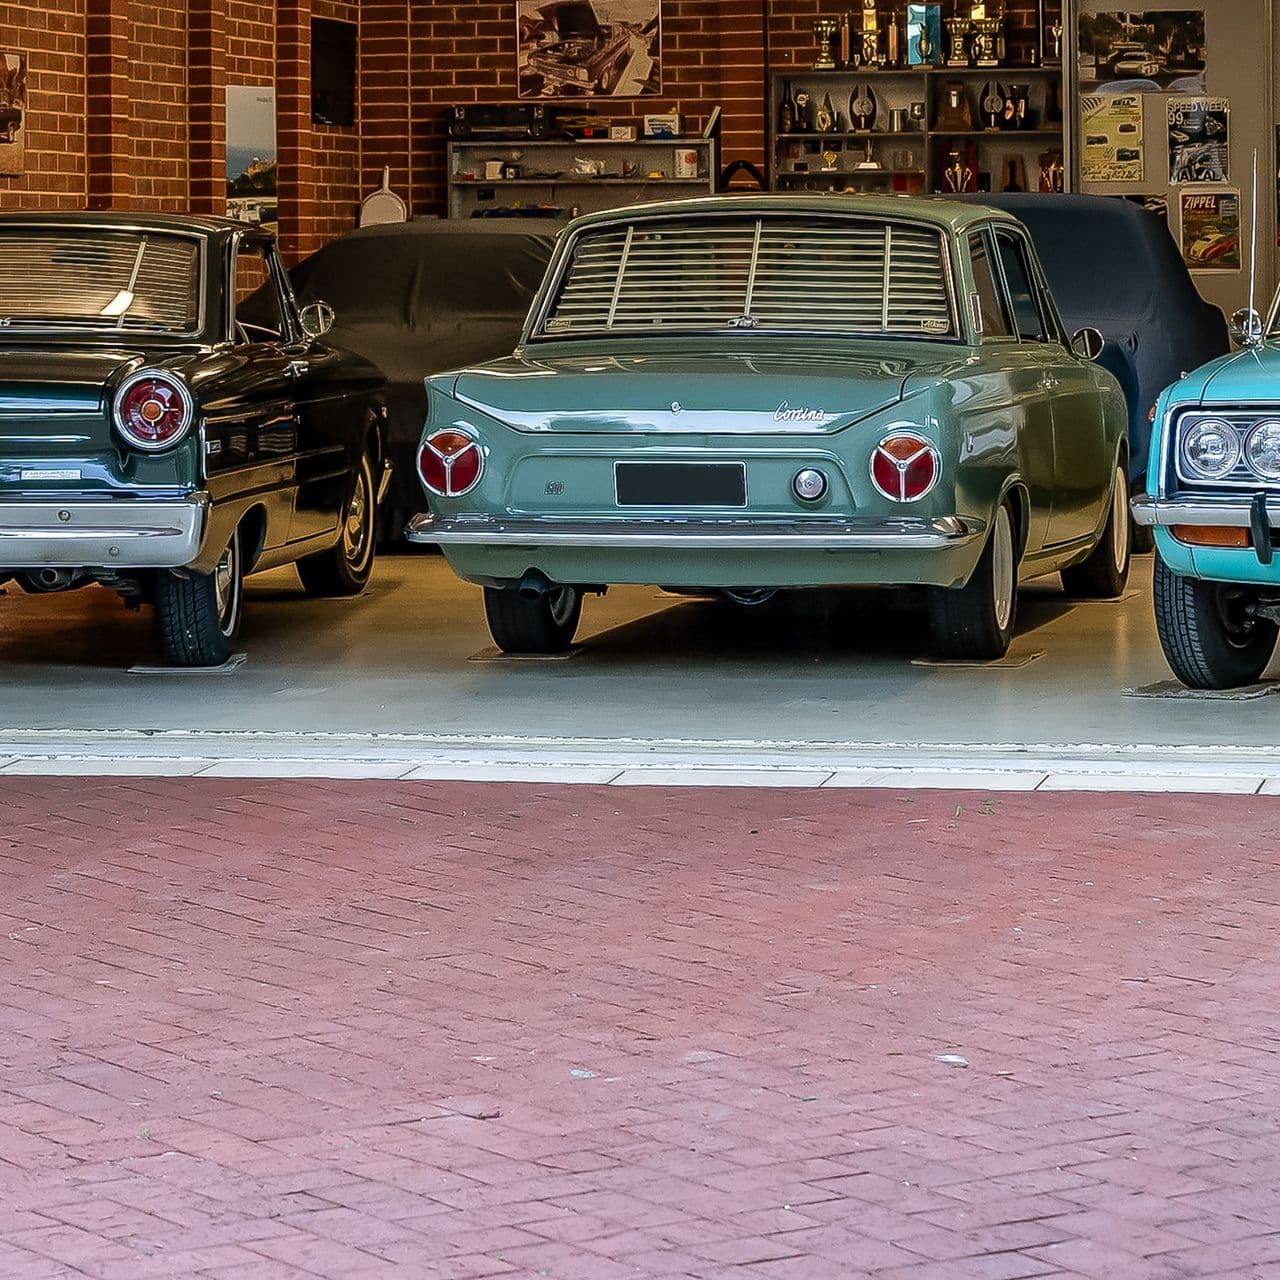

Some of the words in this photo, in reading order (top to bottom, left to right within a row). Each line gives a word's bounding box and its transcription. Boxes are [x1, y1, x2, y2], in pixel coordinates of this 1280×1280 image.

[1167, 102, 1198, 112] SPEED
[1168, 112, 1184, 125] 99
[1184, 195, 1216, 209] ZIPPEL
[773, 400, 825, 422] Cortina
